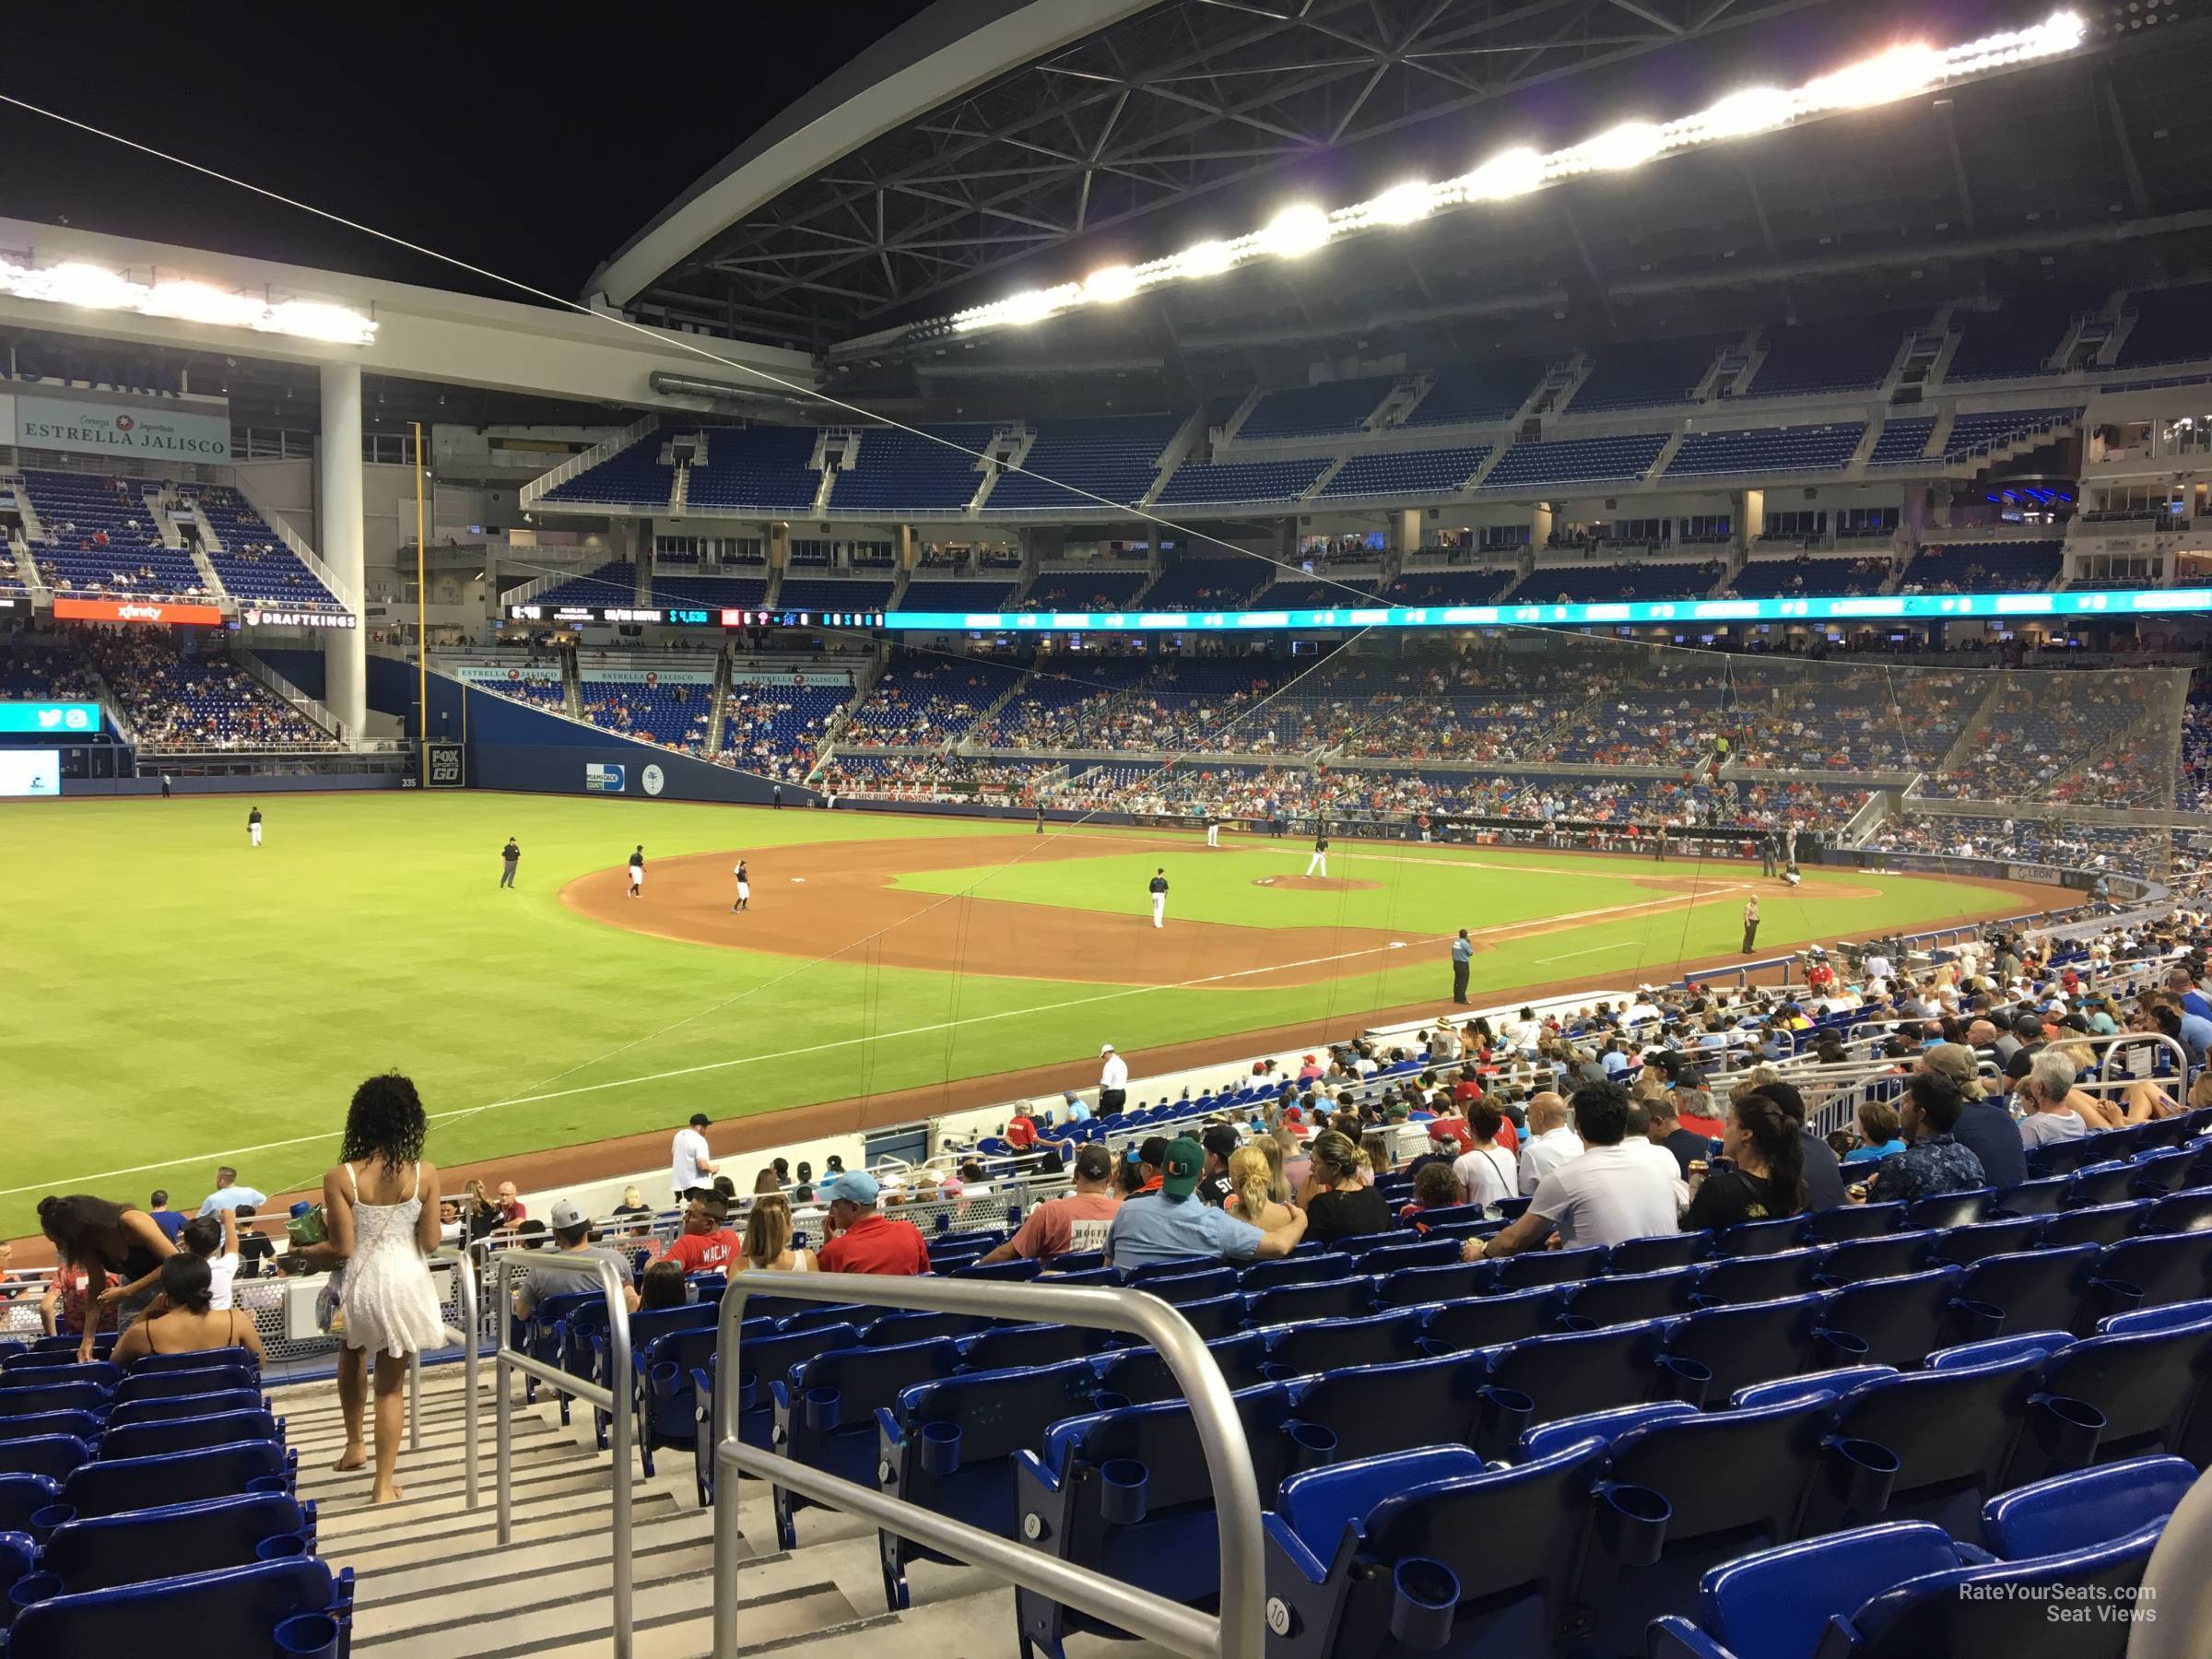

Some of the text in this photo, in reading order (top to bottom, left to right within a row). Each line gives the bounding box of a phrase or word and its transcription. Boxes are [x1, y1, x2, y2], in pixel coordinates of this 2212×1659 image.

[25, 422, 224, 454] ESTRELLA JALISCO
[118, 605, 161, 620] xfinity
[262, 613, 356, 628] DRAFTKINGS
[462, 670, 558, 679] ESTRELLA JALISCO
[432, 749, 459, 763] FOX
[433, 768, 459, 780] GO
[401, 778, 417, 787] 335
[2028, 869, 2053, 880] LEON
[1215, 1177, 1233, 1193] ST
[1029, 1519, 1035, 1533] 9
[1272, 1605, 1284, 1628] 10
